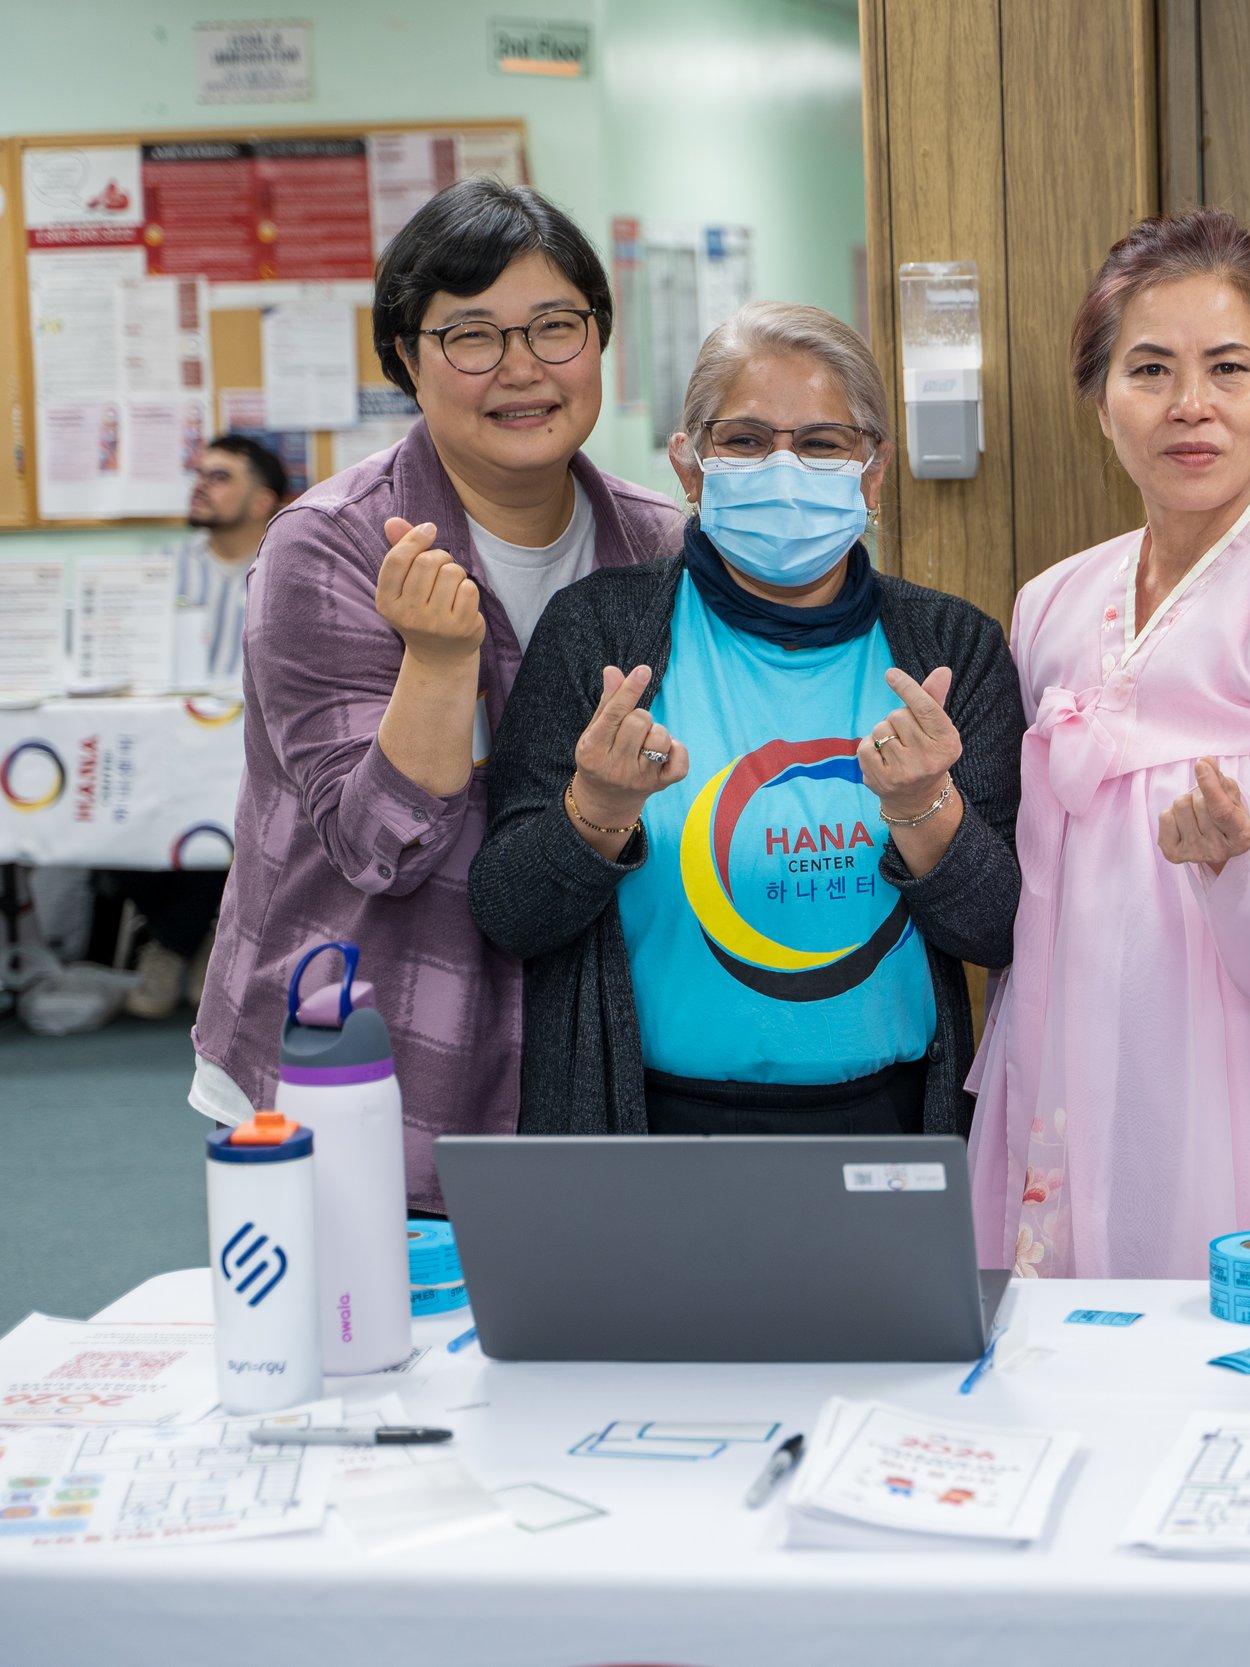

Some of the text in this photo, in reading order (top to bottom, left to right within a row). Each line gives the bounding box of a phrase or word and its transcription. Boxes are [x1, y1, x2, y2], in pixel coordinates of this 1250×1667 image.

[766, 821, 875, 855] HANA
[788, 855, 855, 873] CENTER
[766, 873, 875, 904] 하나센터
[337, 1292, 352, 1343] owala
[4, 1393, 136, 1408] 2026
